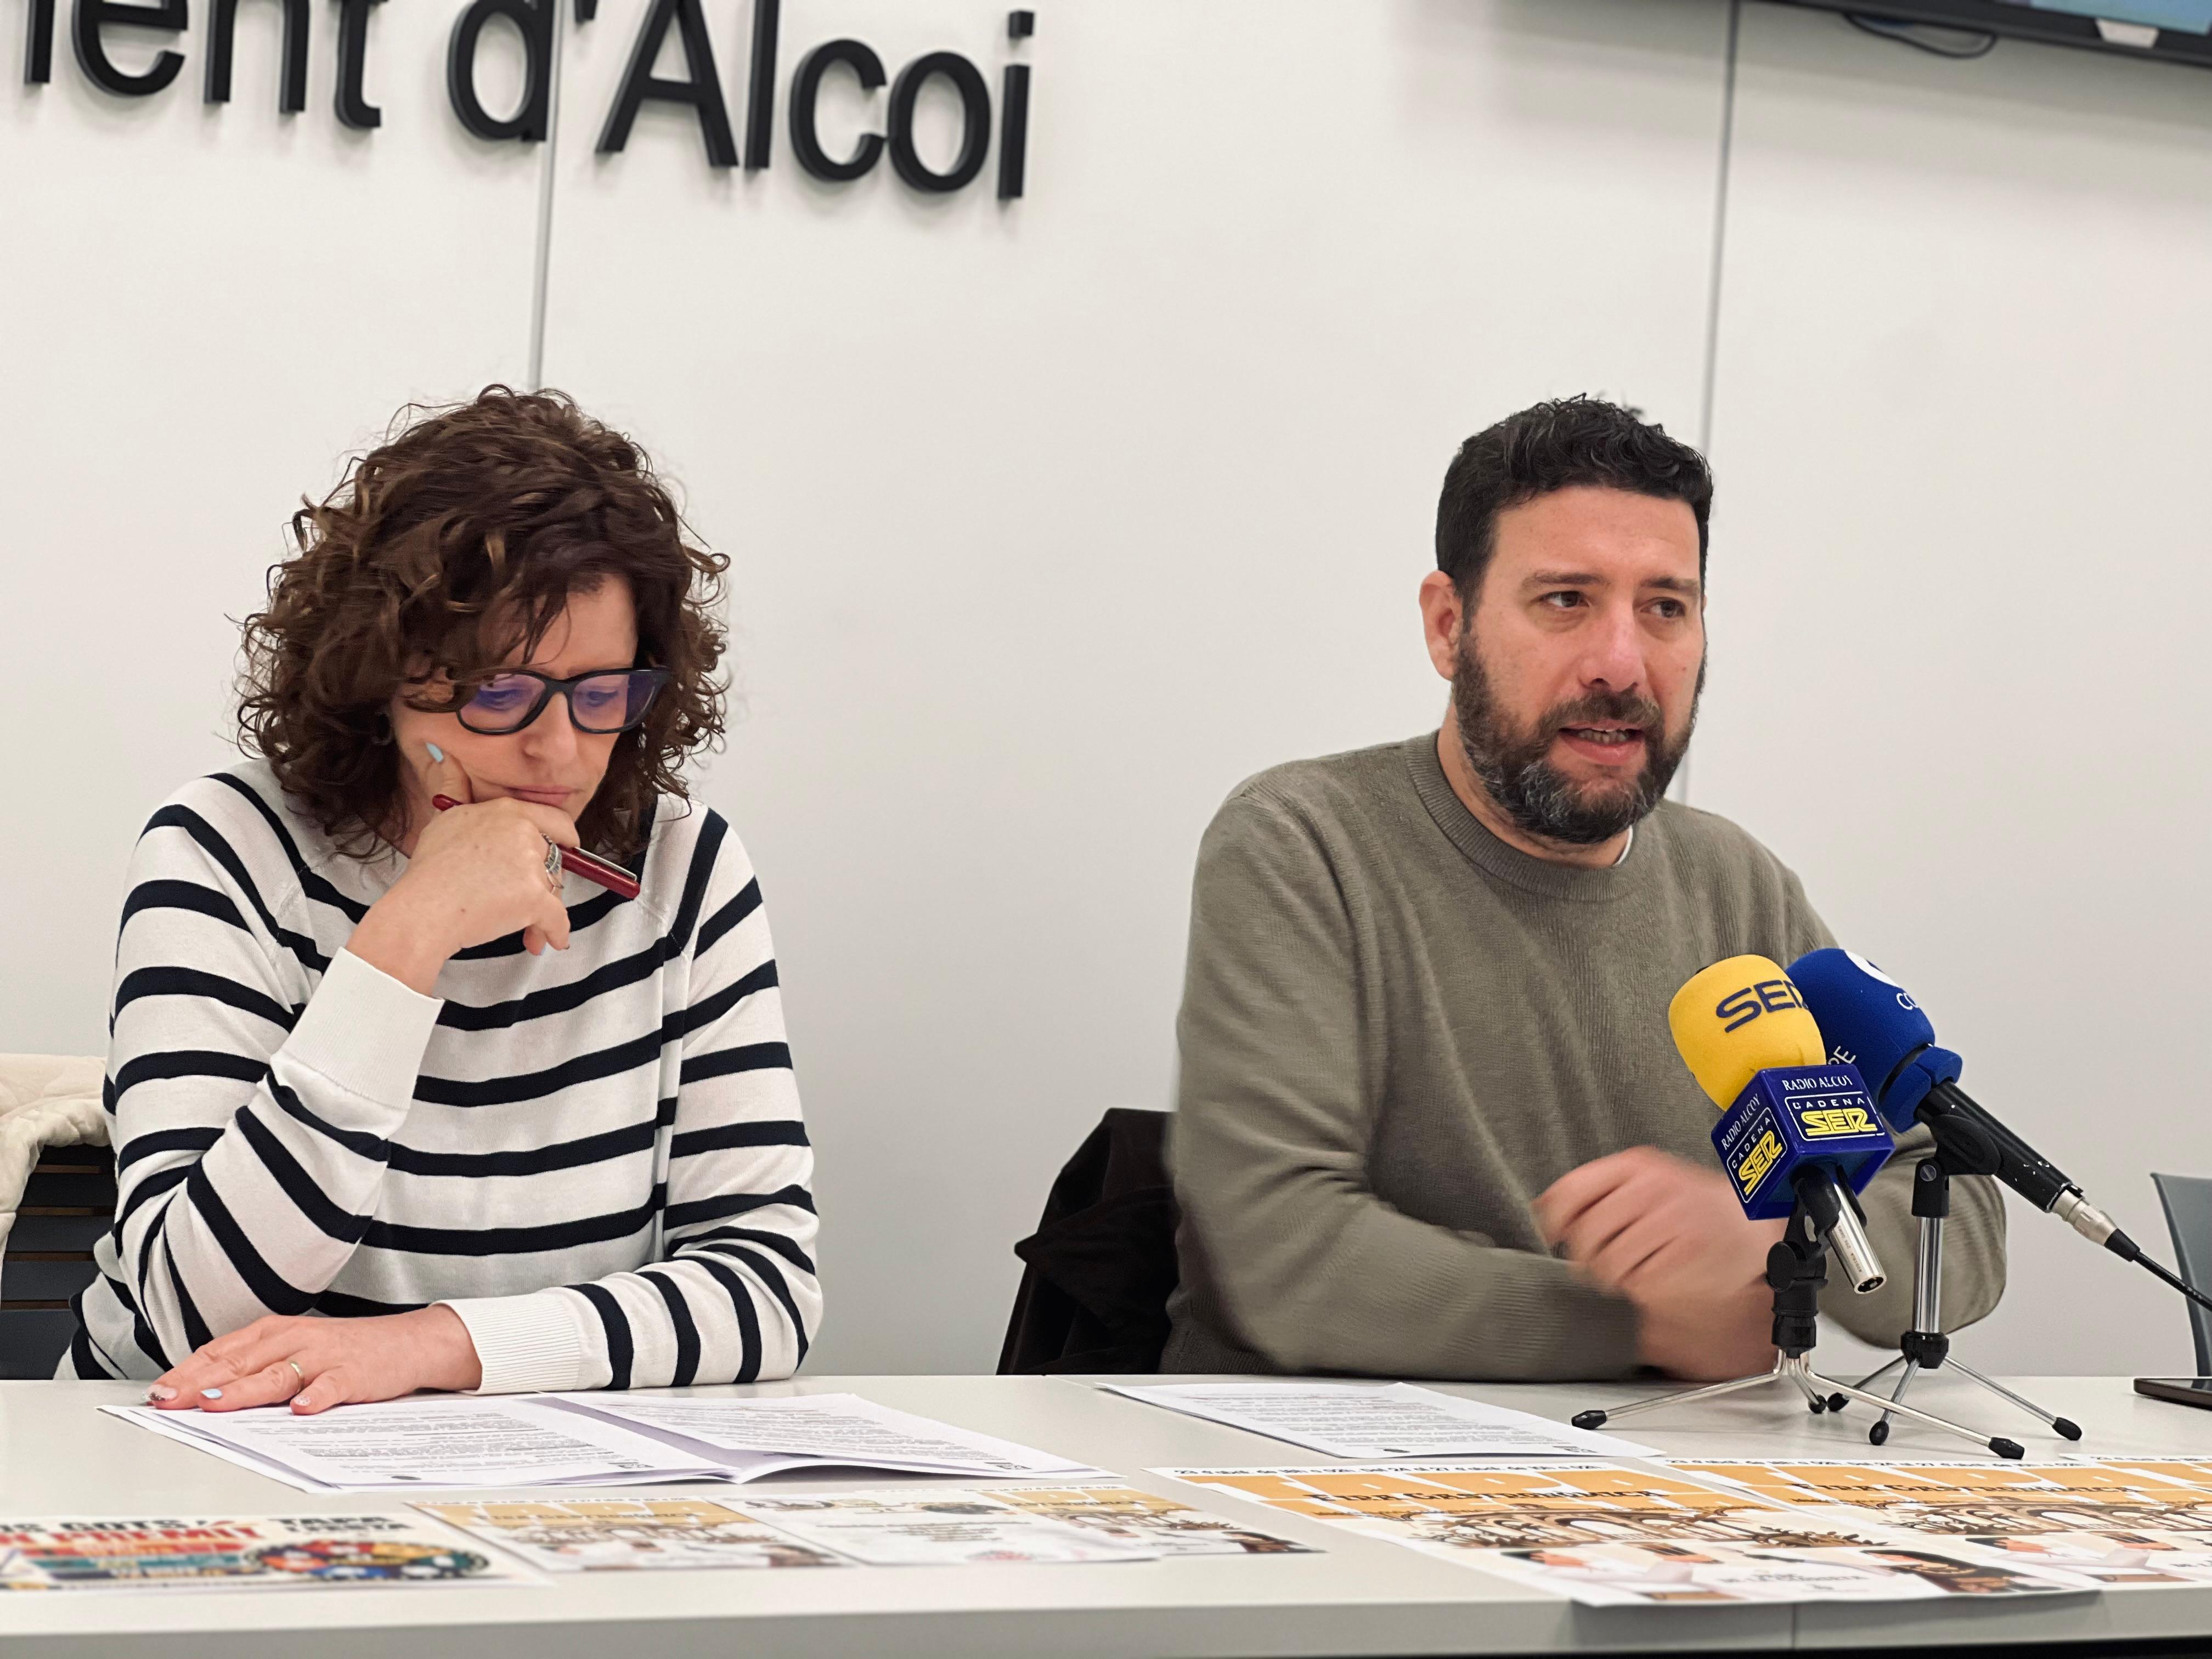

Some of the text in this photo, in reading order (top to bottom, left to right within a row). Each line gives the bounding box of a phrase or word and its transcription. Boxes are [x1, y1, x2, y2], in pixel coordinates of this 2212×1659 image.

[1782, 1077, 1817, 1091] RADIO
[1792, 1097, 1865, 1110] CADENA
[1721, 1093, 1760, 1150] RADIO ALCOY
[1801, 1108, 1878, 1136] SER
[1731, 1117, 1771, 1169] CADENA
[1739, 1130, 1783, 1195] SER
